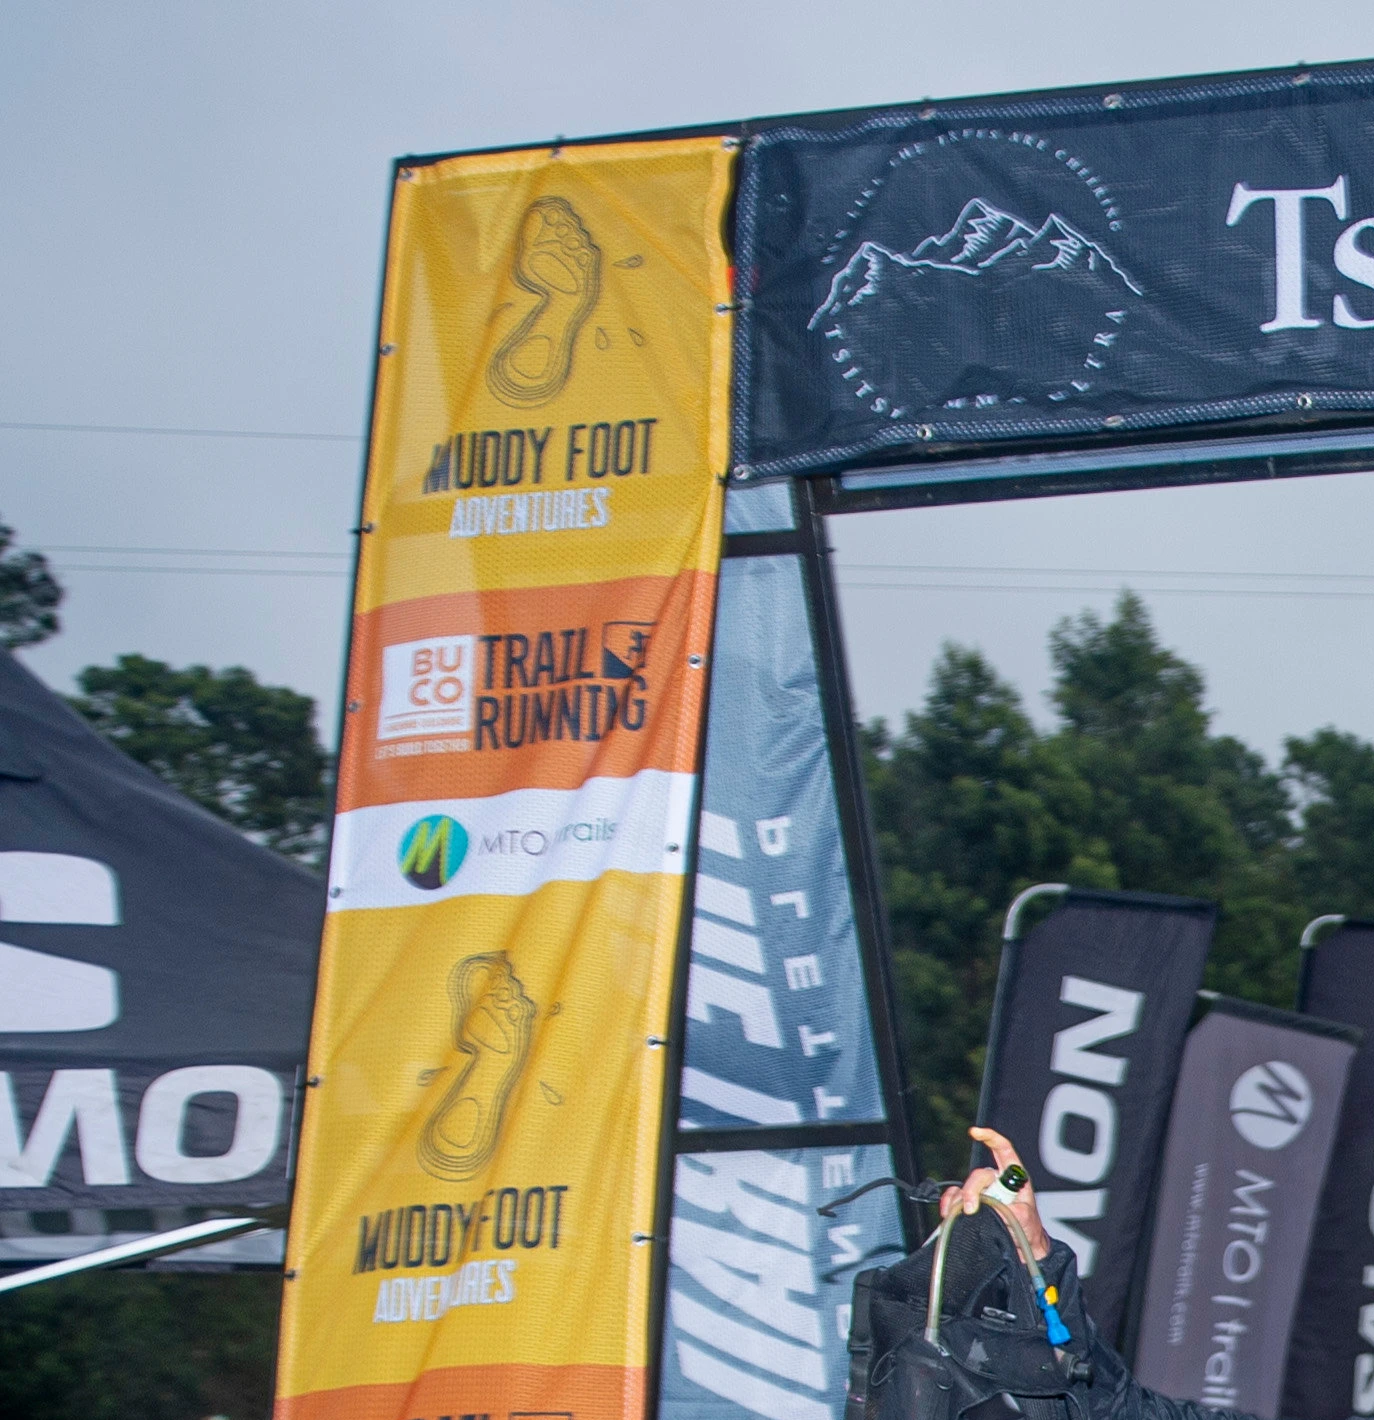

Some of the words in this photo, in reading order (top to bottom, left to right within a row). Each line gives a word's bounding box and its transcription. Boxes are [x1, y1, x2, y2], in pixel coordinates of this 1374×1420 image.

[422, 427, 550, 494] MUDDY
[566, 418, 659, 481] FOOT
[449, 487, 609, 539] ADVENTURES
[409, 676, 464, 707] CO
[412, 645, 464, 677] BU
[477, 627, 594, 690] TRAIL
[474, 674, 647, 751] RUNNING
[478, 830, 547, 857] MTO
[353, 1203, 474, 1275] MUDDY
[1222, 1168, 1275, 1283] MTO
[1200, 1319, 1250, 1411] trail
